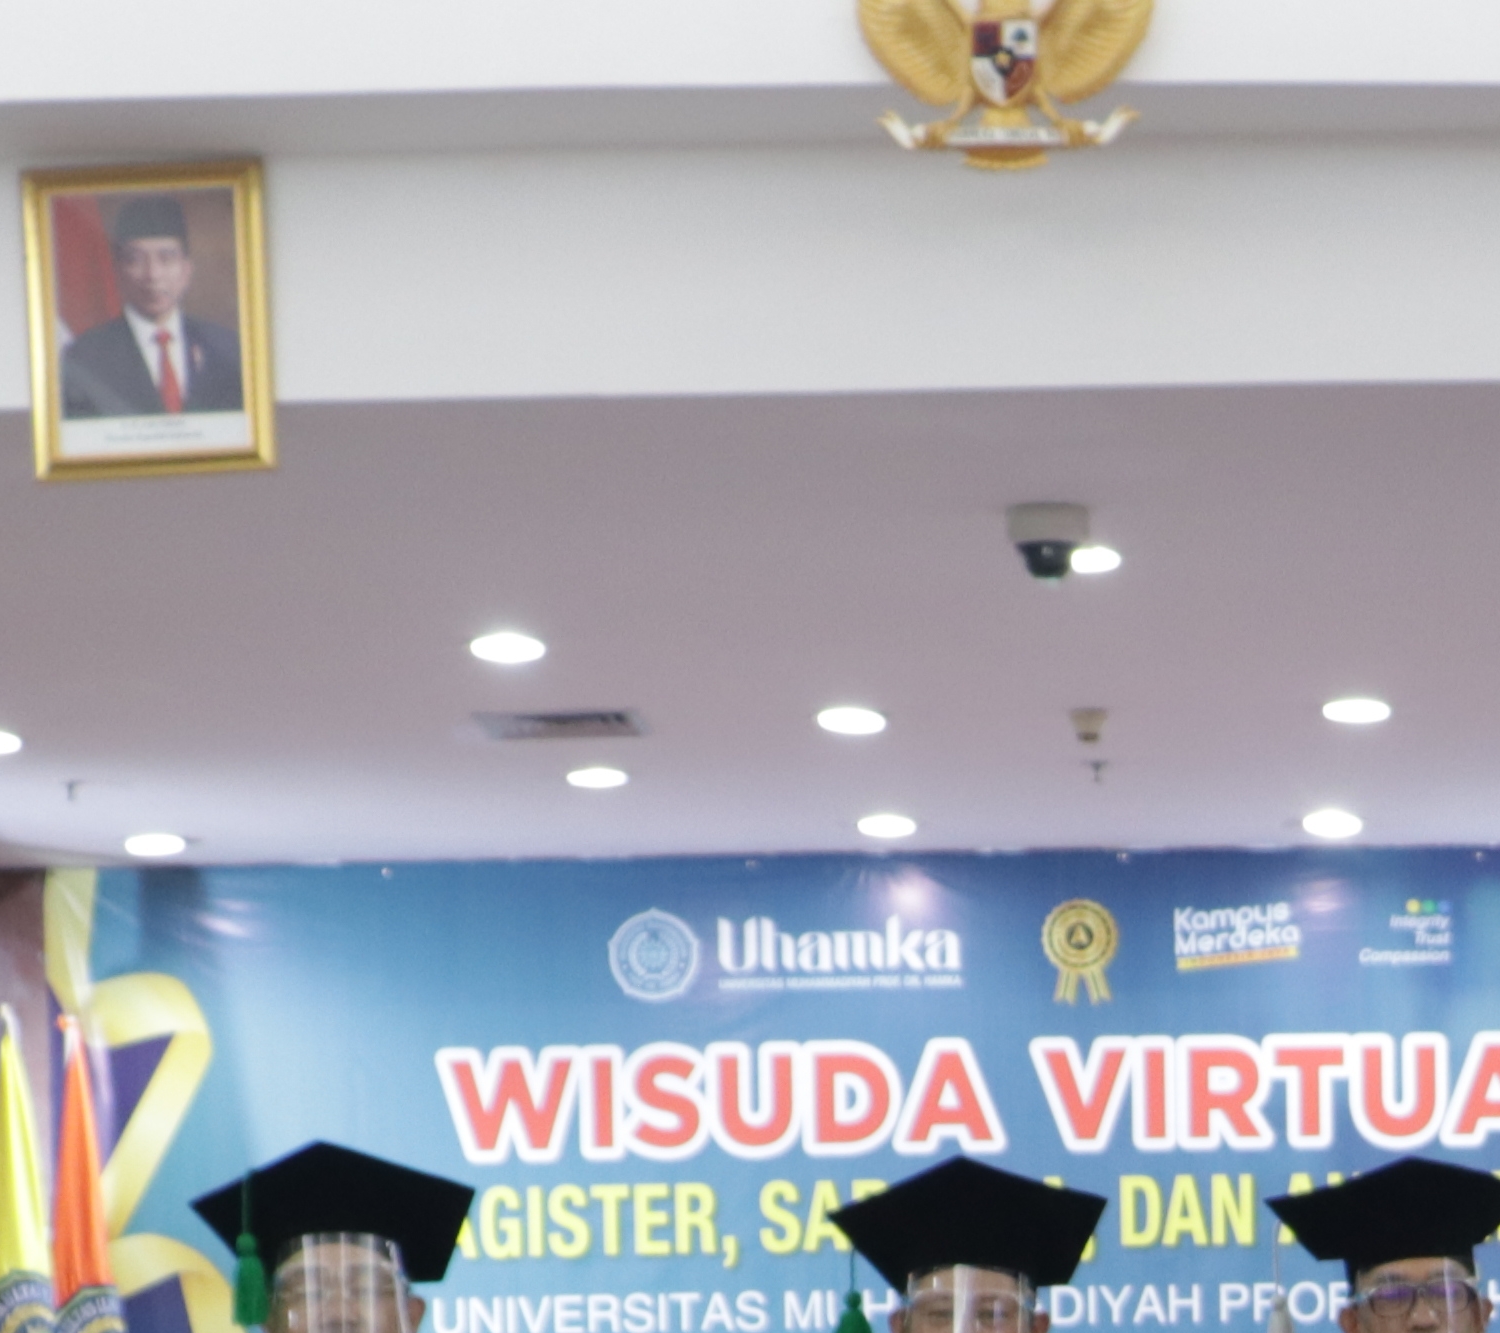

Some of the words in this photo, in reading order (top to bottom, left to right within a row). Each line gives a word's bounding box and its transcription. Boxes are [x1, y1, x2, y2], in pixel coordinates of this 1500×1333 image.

[1174, 902, 1291, 933] Kampus
[716, 914, 963, 974] Uhamka
[1175, 925, 1299, 956] Merdeka
[1359, 948, 1450, 966] Compassion
[440, 1040, 1003, 1160] WISUDA
[1118, 1174, 1258, 1251] DAN
